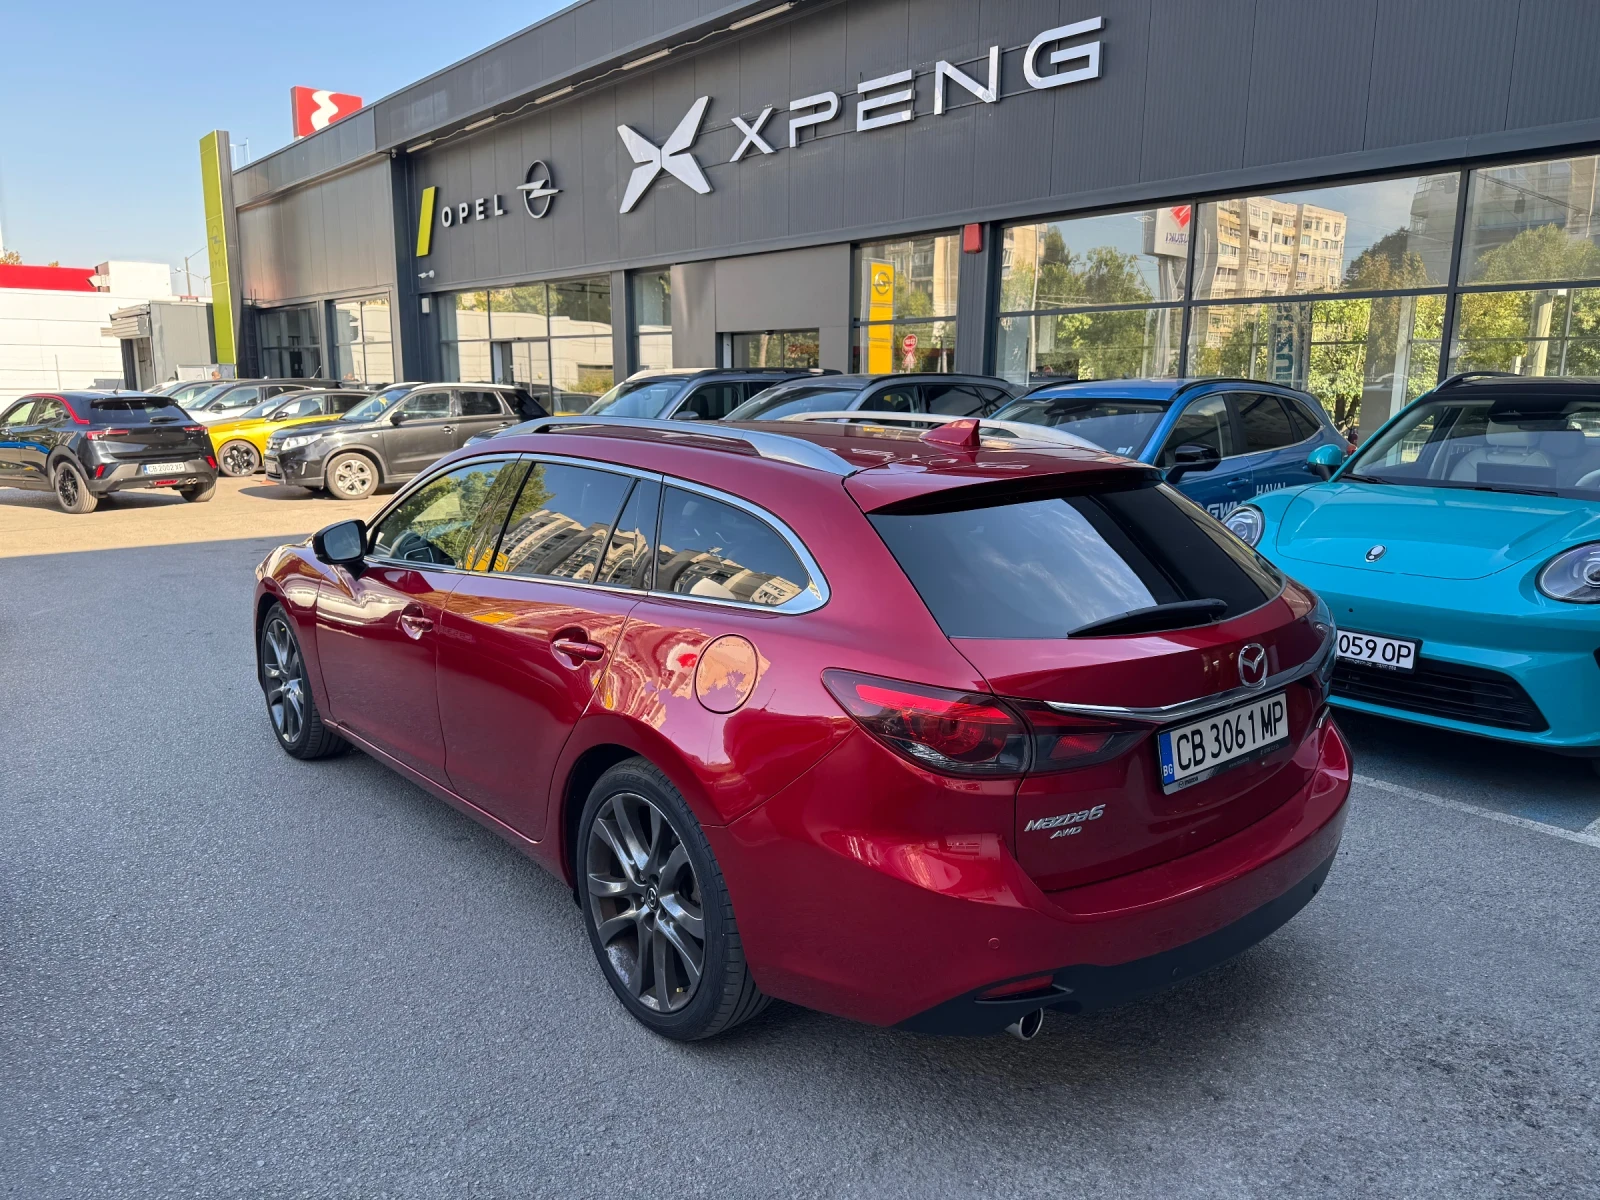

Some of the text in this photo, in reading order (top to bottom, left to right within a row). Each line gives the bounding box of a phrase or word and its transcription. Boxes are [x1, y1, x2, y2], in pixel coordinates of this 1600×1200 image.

[729, 16, 1106, 162] XPENG
[441, 194, 505, 228] OPEL
[1339, 634, 1377, 658] 059
[1382, 642, 1412, 664] OP
[1177, 701, 1284, 771] CB 3061 MP
[1163, 763, 1174, 777] BG
[1050, 826, 1082, 840] AWD
